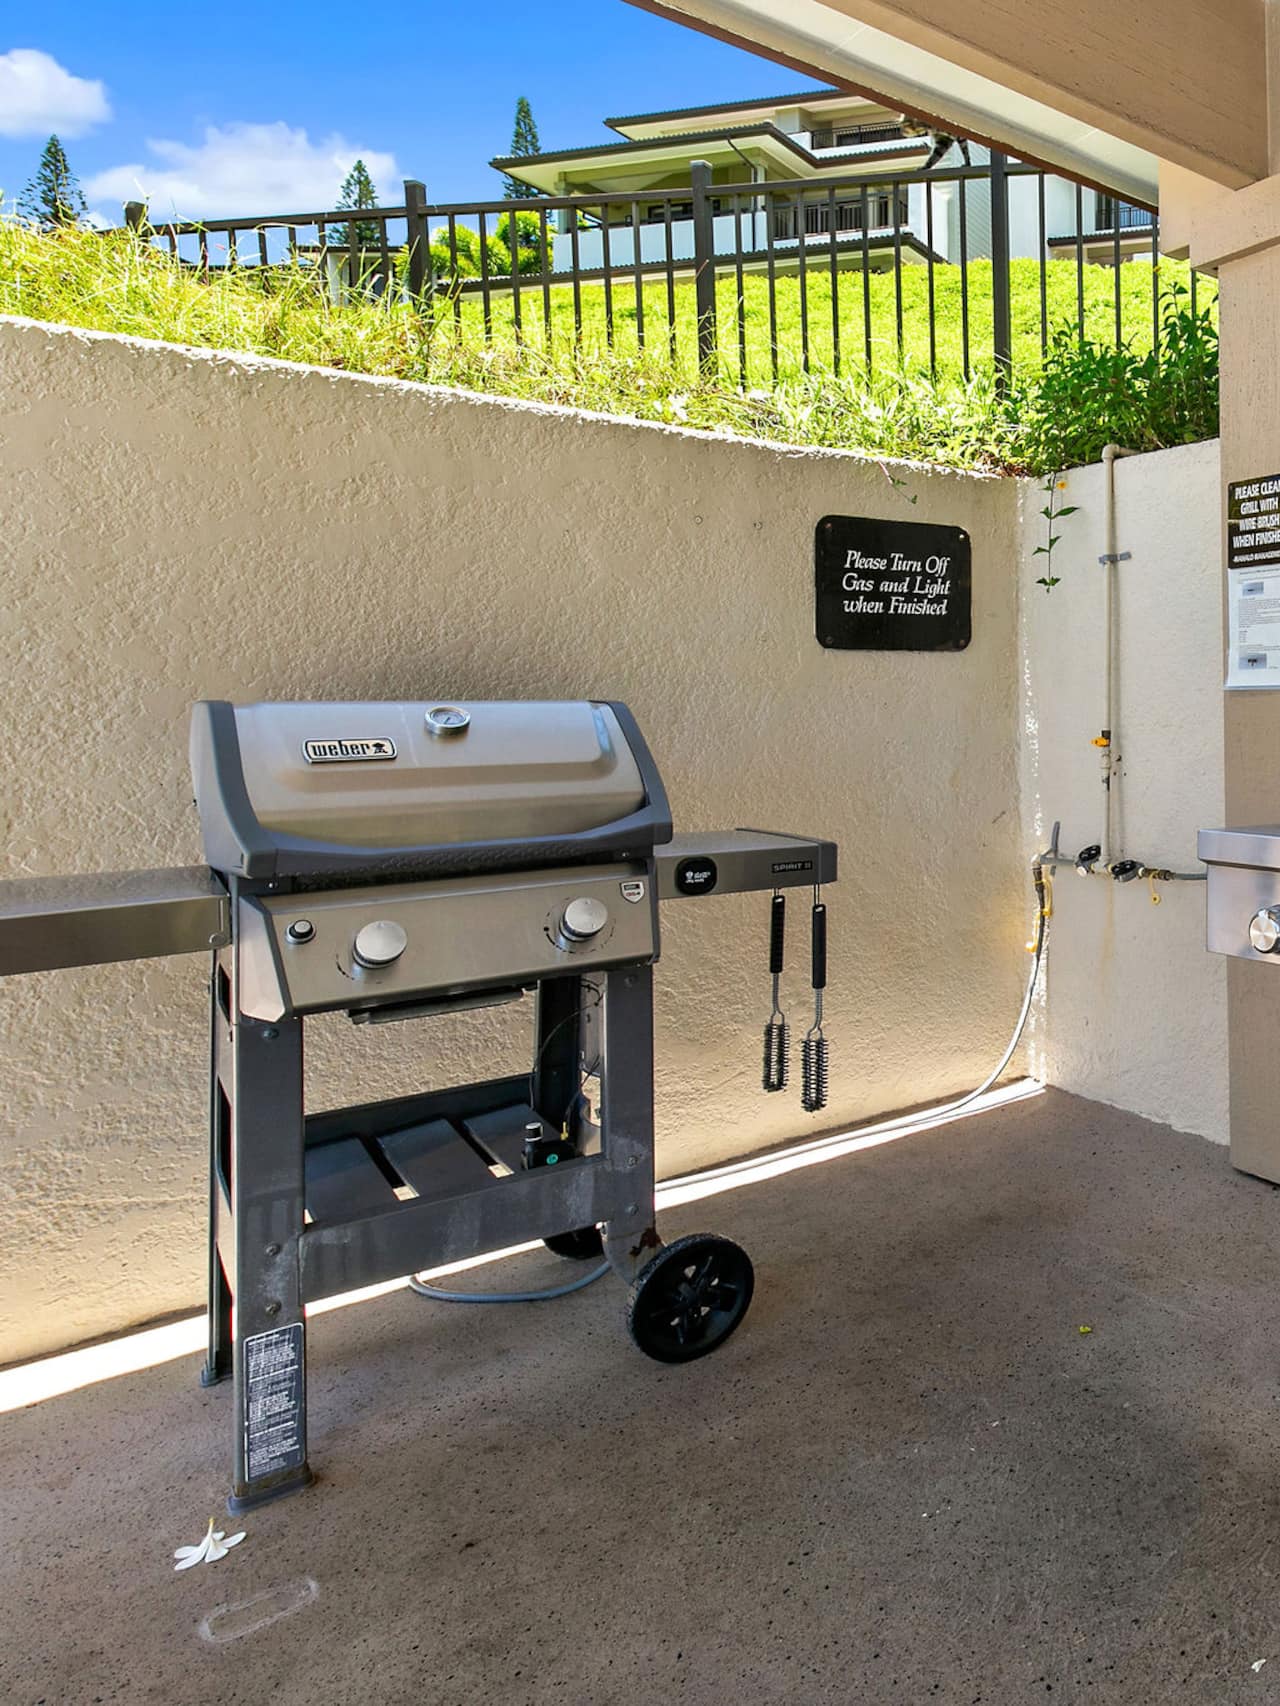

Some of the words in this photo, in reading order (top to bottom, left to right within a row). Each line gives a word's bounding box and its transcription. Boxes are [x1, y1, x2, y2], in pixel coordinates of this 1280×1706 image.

[1234, 483, 1260, 500] PLEASE
[1240, 499, 1259, 515] GRILL
[1259, 497, 1279, 513] WITH
[1239, 516, 1257, 532] WIRE
[1257, 513, 1280, 529] BRUSH
[1232, 532, 1255, 549] WHEN
[844, 550, 887, 571] Please
[890, 553, 922, 573] Turn
[925, 555, 951, 577] Off
[842, 572, 874, 592] Gas
[879, 577, 910, 593] and
[913, 576, 951, 598] Light
[843, 596, 885, 614] when
[888, 596, 948, 616] Finished
[311, 740, 370, 757] weber
